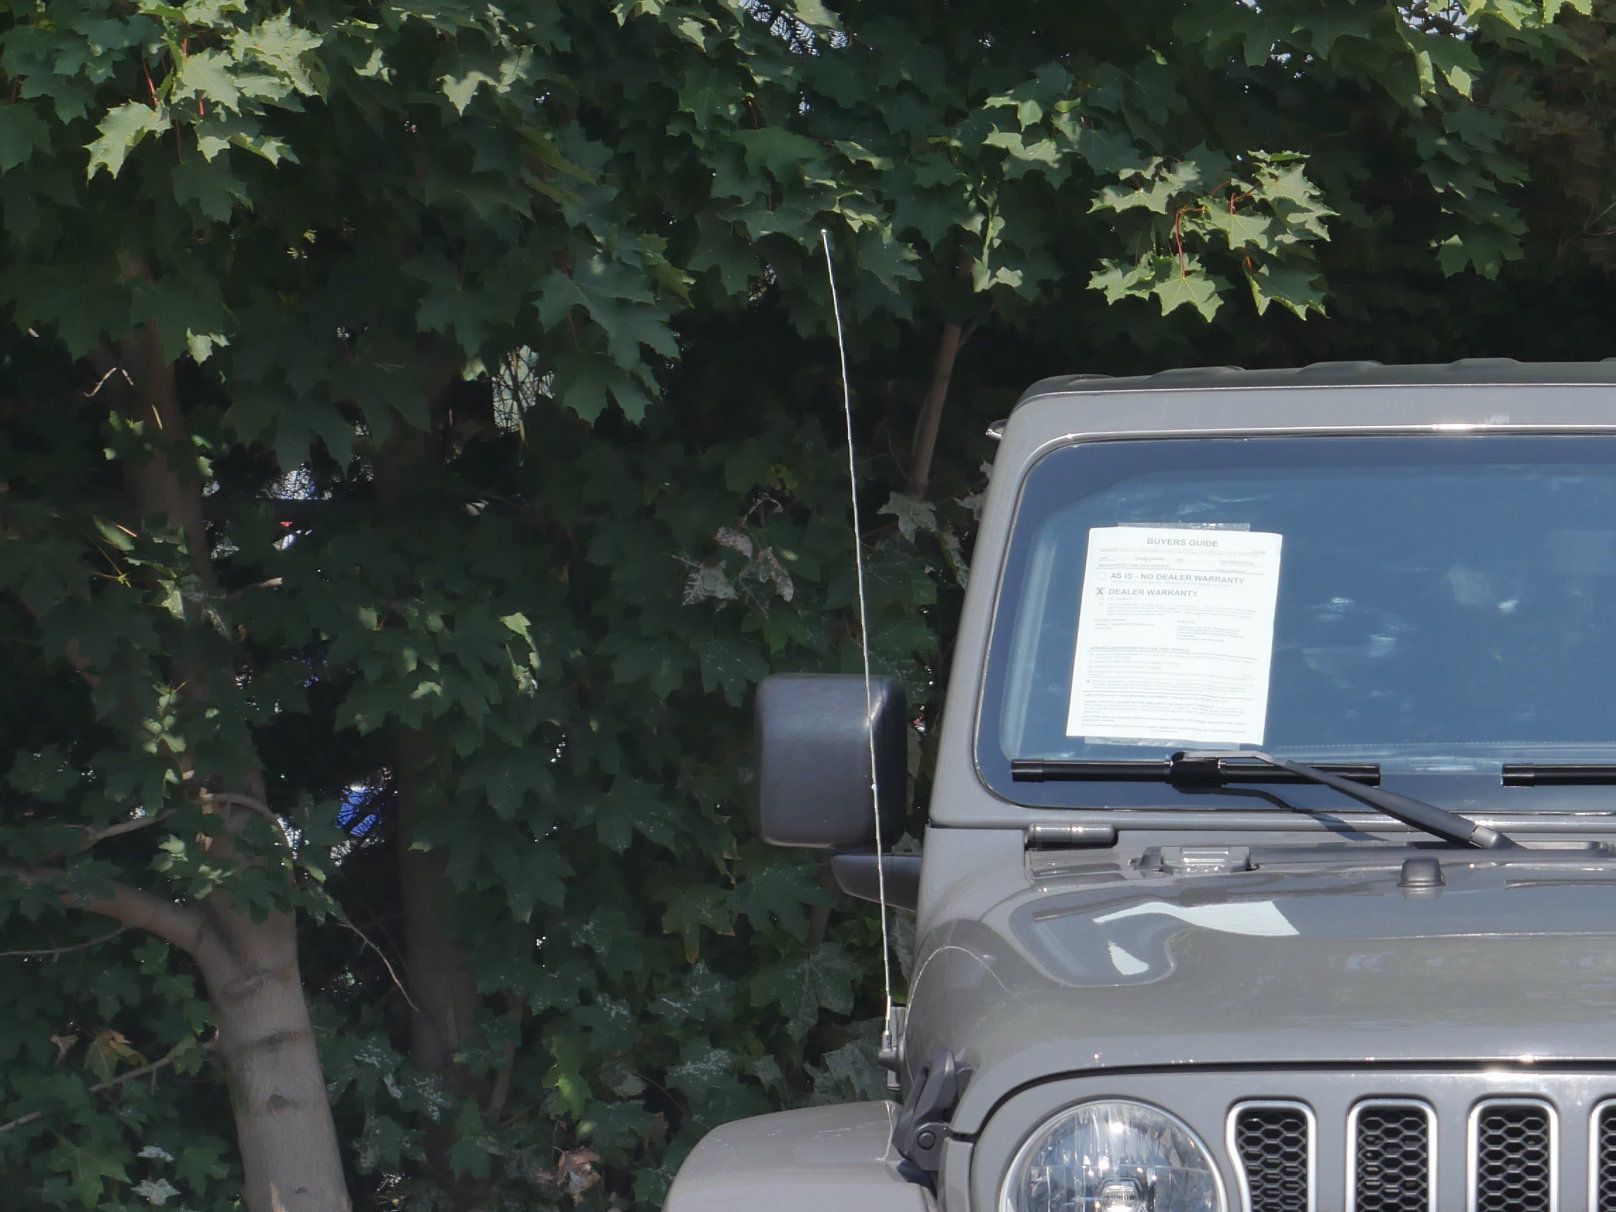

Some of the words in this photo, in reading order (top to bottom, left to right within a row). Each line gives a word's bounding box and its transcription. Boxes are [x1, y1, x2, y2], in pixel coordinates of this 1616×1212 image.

[1146, 537, 1187, 546] BUYERS
[1188, 539, 1220, 548] GUIDE
[1140, 573, 1154, 581] NO
[1155, 574, 1193, 583] DEALER
[1194, 575, 1246, 585] WARRANTY
[1108, 588, 1145, 597] DEALER
[1146, 588, 1199, 598] WARRANTY
